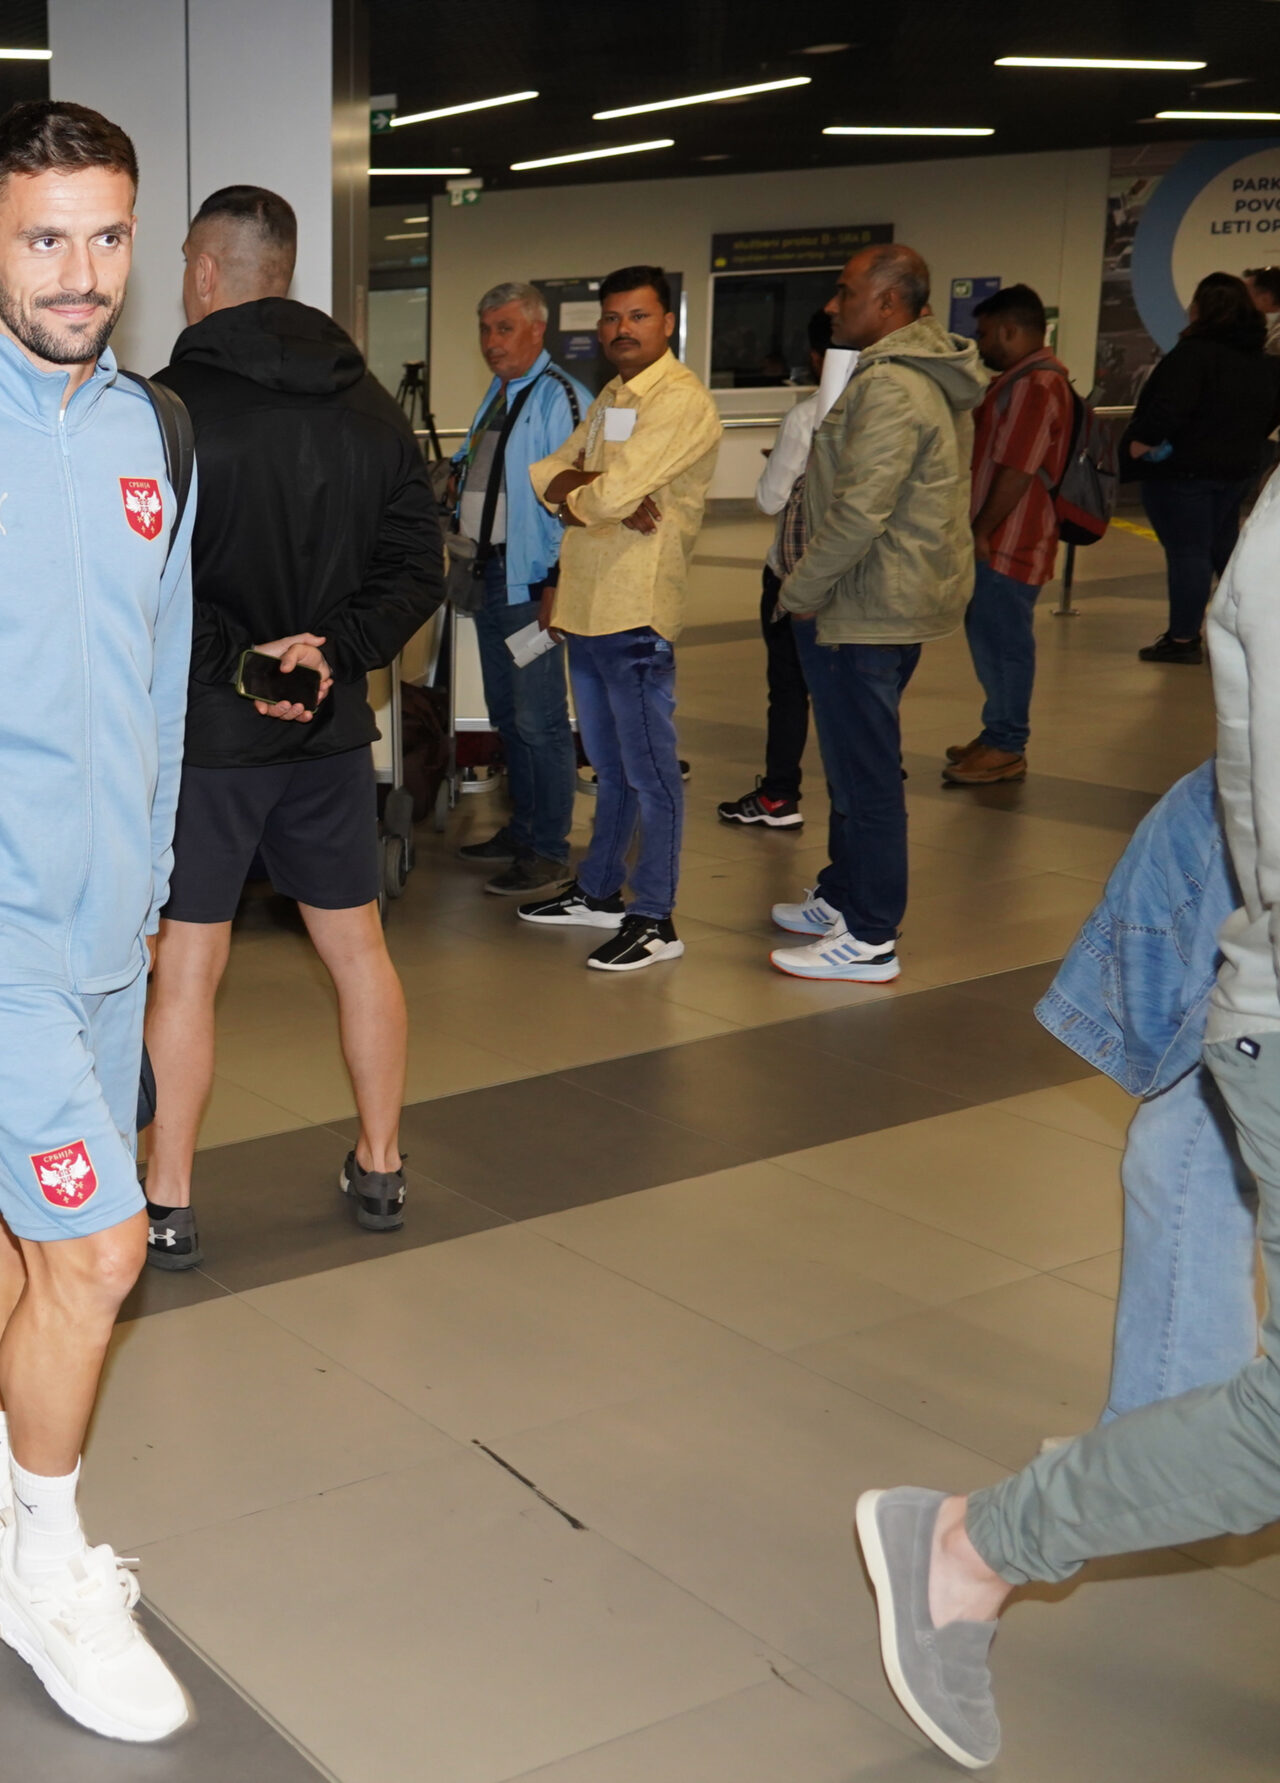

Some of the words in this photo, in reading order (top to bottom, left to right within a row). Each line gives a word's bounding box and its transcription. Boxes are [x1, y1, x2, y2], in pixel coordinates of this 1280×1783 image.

[1211, 220, 1251, 234] LETI
[128, 481, 151, 489] СРБИЈА
[42, 1148, 74, 1163] СРБИЈА
